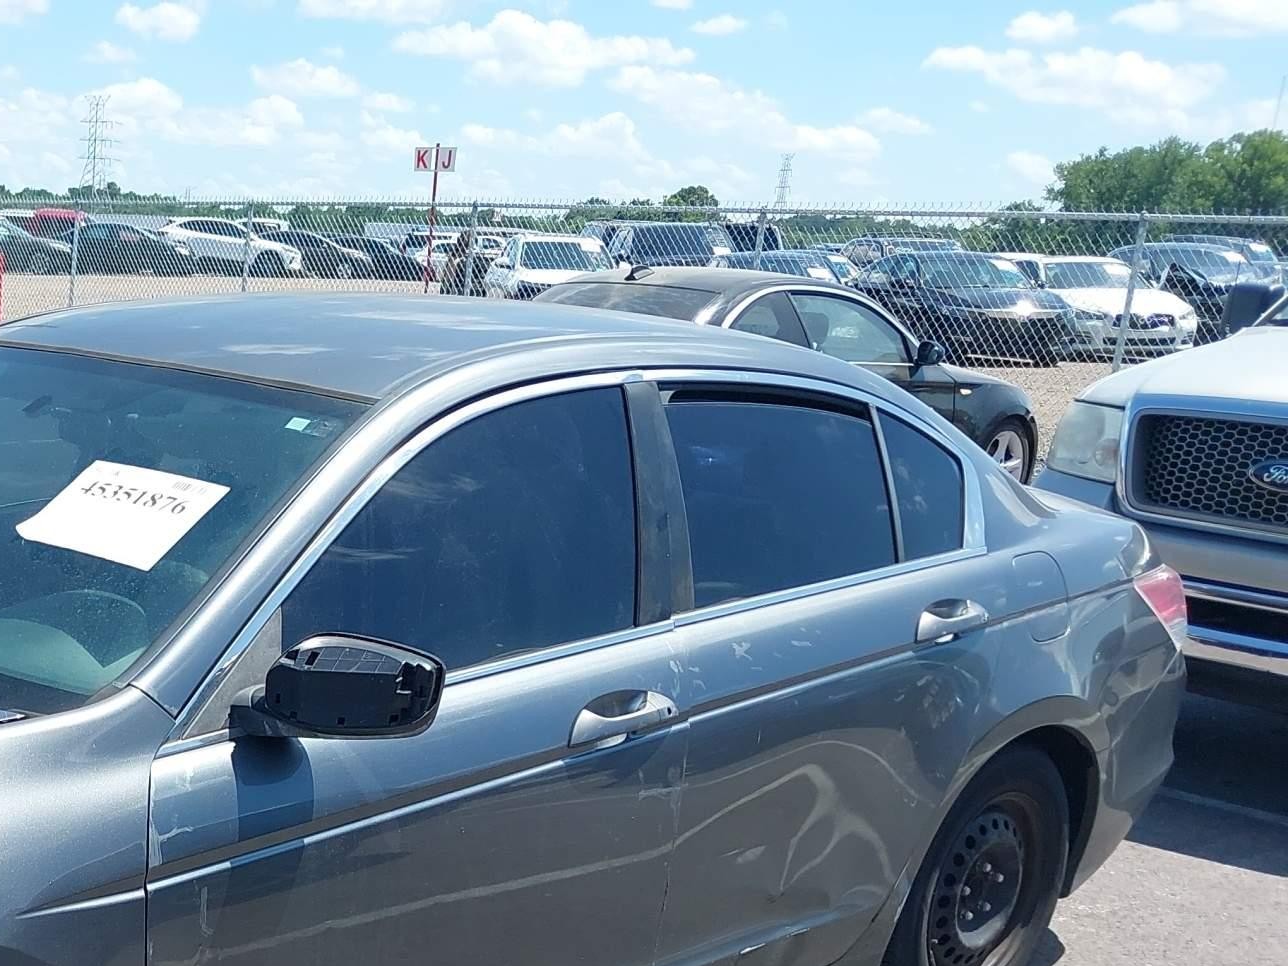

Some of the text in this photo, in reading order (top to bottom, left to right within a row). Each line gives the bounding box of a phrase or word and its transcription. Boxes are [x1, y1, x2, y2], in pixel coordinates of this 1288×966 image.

[416, 149, 453, 169] K J
[81, 480, 188, 515] 45351876
